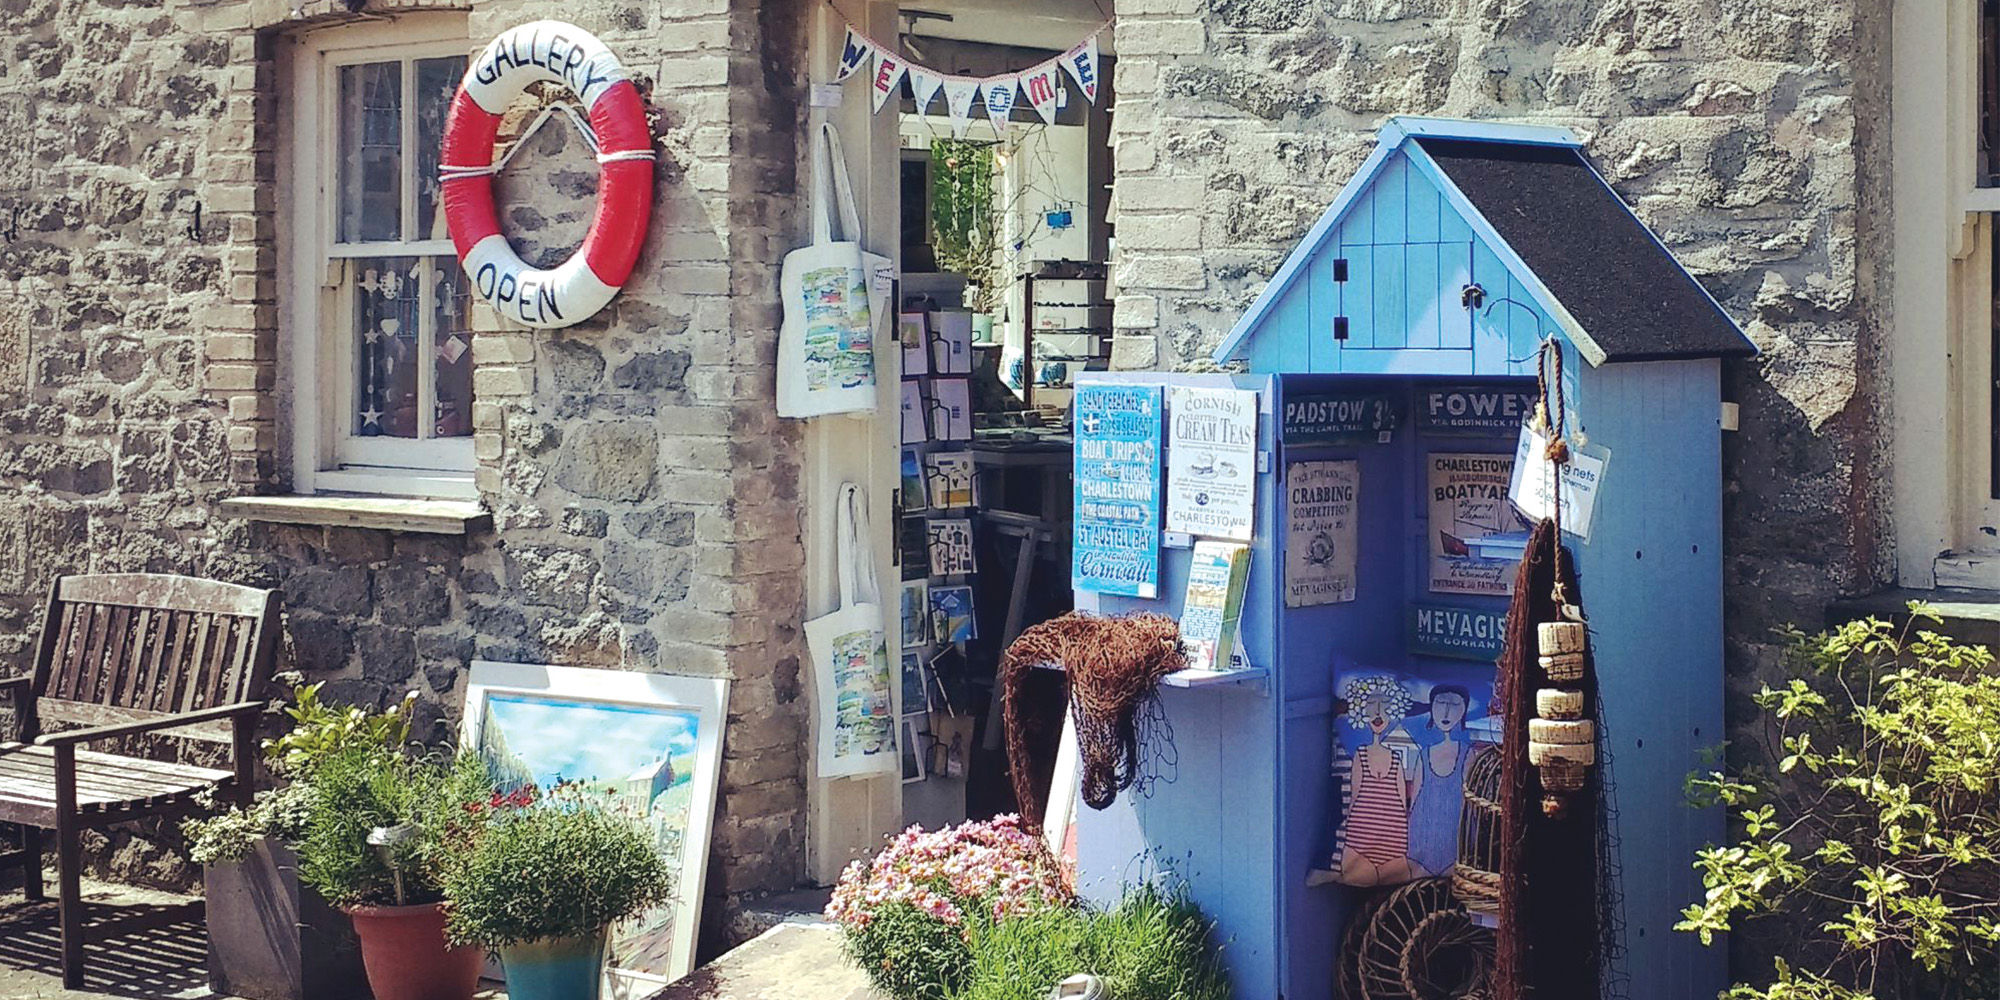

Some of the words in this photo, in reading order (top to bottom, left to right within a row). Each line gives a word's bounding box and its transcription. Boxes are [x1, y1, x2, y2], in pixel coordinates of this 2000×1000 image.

[475, 28, 609, 98] GALLERY
[476, 262, 564, 324] OPEN
[1083, 391, 1106, 410] SANDY
[1108, 392, 1142, 413] BEACHES
[1185, 397, 1242, 417] CORNISH
[1285, 400, 1365, 424] PADSTOW
[1429, 393, 1539, 416] FOWEY
[1176, 414, 1218, 442] CREAM
[1220, 417, 1252, 445] TEAS
[1285, 426, 1298, 434] VIA
[1300, 425, 1315, 433] THE
[1317, 424, 1340, 433] CAMEL
[1082, 439, 1107, 459] BOAT
[1111, 440, 1142, 461] TRIPS
[1573, 467, 1596, 482] nets
[1082, 479, 1152, 501] CHARLESTOWN
[1292, 485, 1353, 504] CRABBING
[1435, 484, 1509, 501] BOATYAR
[1098, 503, 1122, 519] COASTAL
[1173, 510, 1247, 528] CHARLESTOWN
[1293, 504, 1350, 519] COMPETITION
[1079, 523, 1092, 546] ST
[1092, 525, 1133, 549] AUSTELL
[1133, 529, 1153, 552] BAY
[1080, 551, 1151, 582] Cornwall
[1418, 609, 1506, 641] MEVAGIS
[1444, 637, 1496, 650] GORRAN
